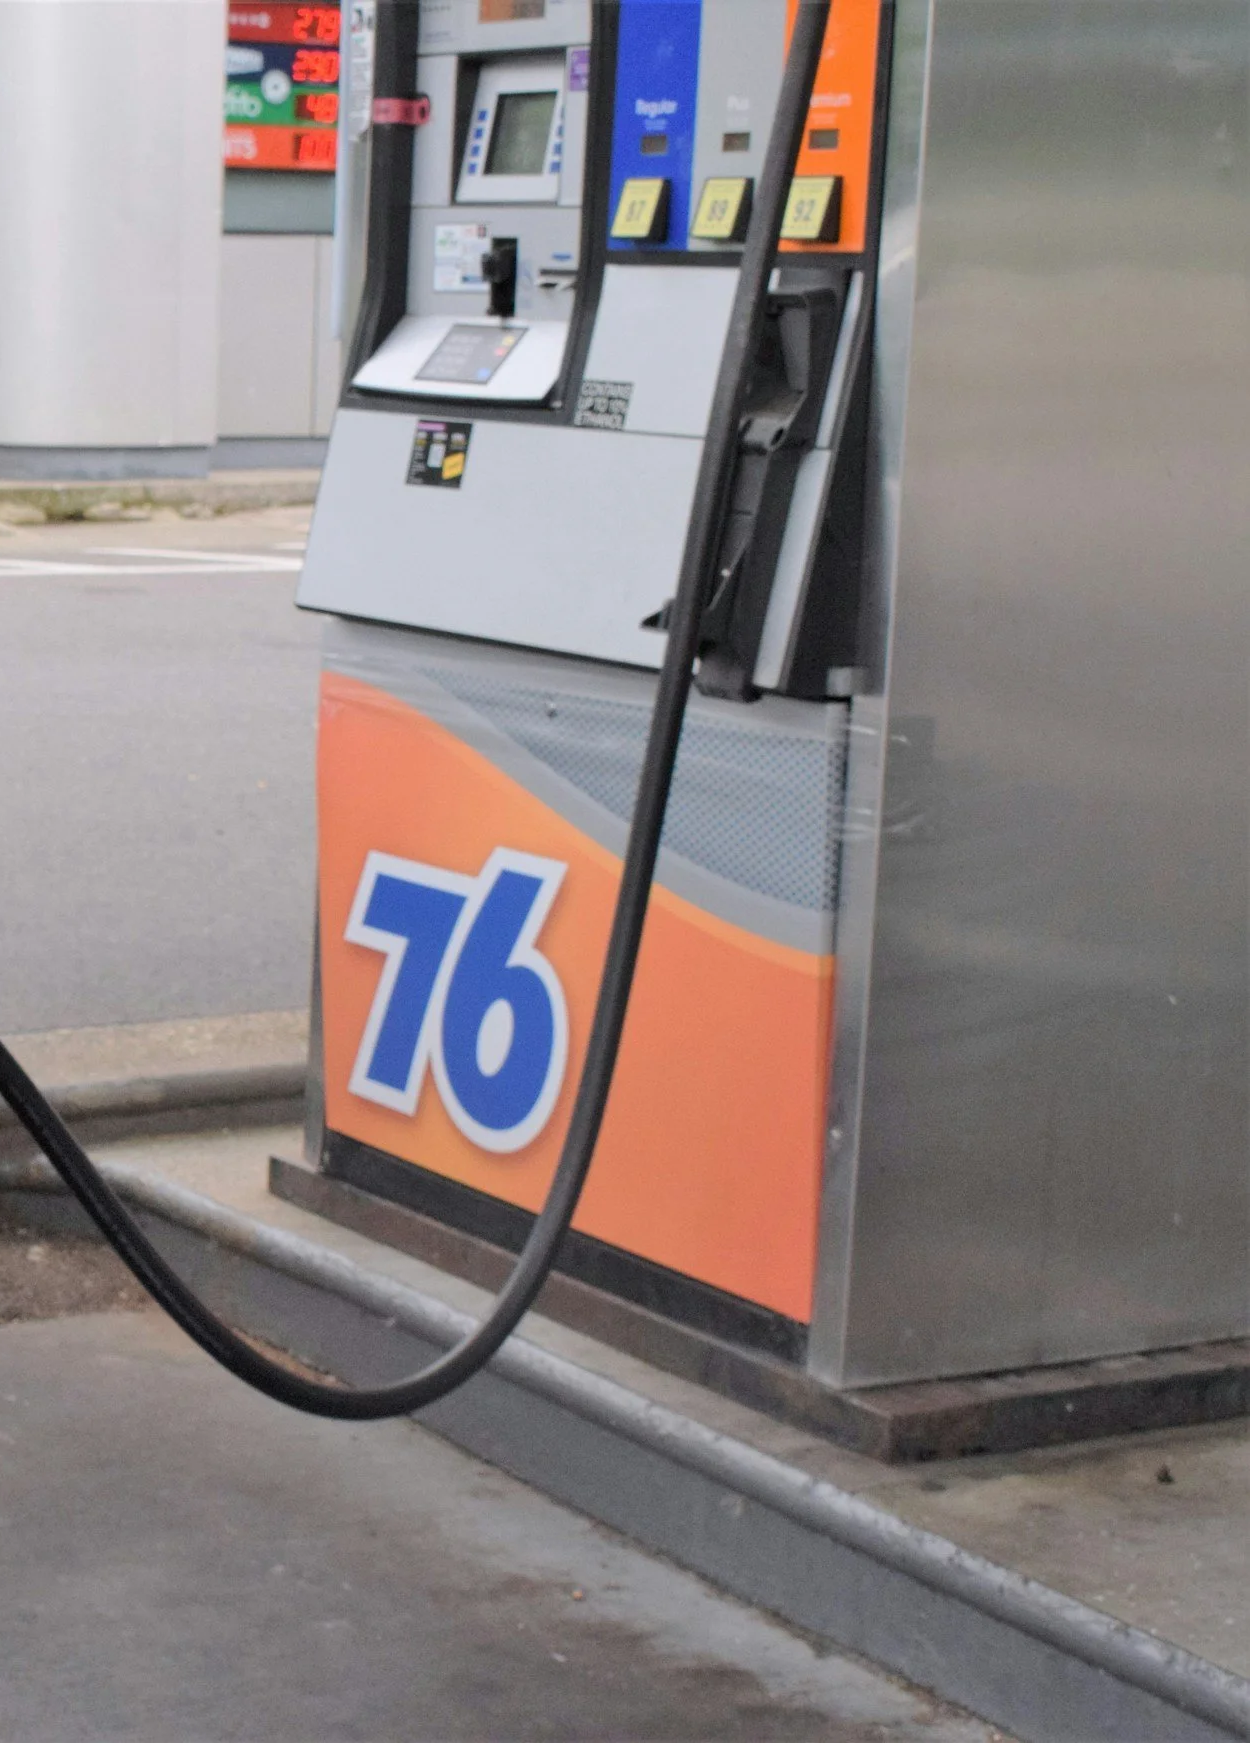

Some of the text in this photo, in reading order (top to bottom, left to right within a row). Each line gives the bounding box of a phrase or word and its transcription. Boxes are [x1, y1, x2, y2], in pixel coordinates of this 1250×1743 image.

[625, 200, 646, 222] 87
[707, 200, 728, 221] 89
[794, 200, 817, 222] 92
[346, 848, 567, 1153] 76
